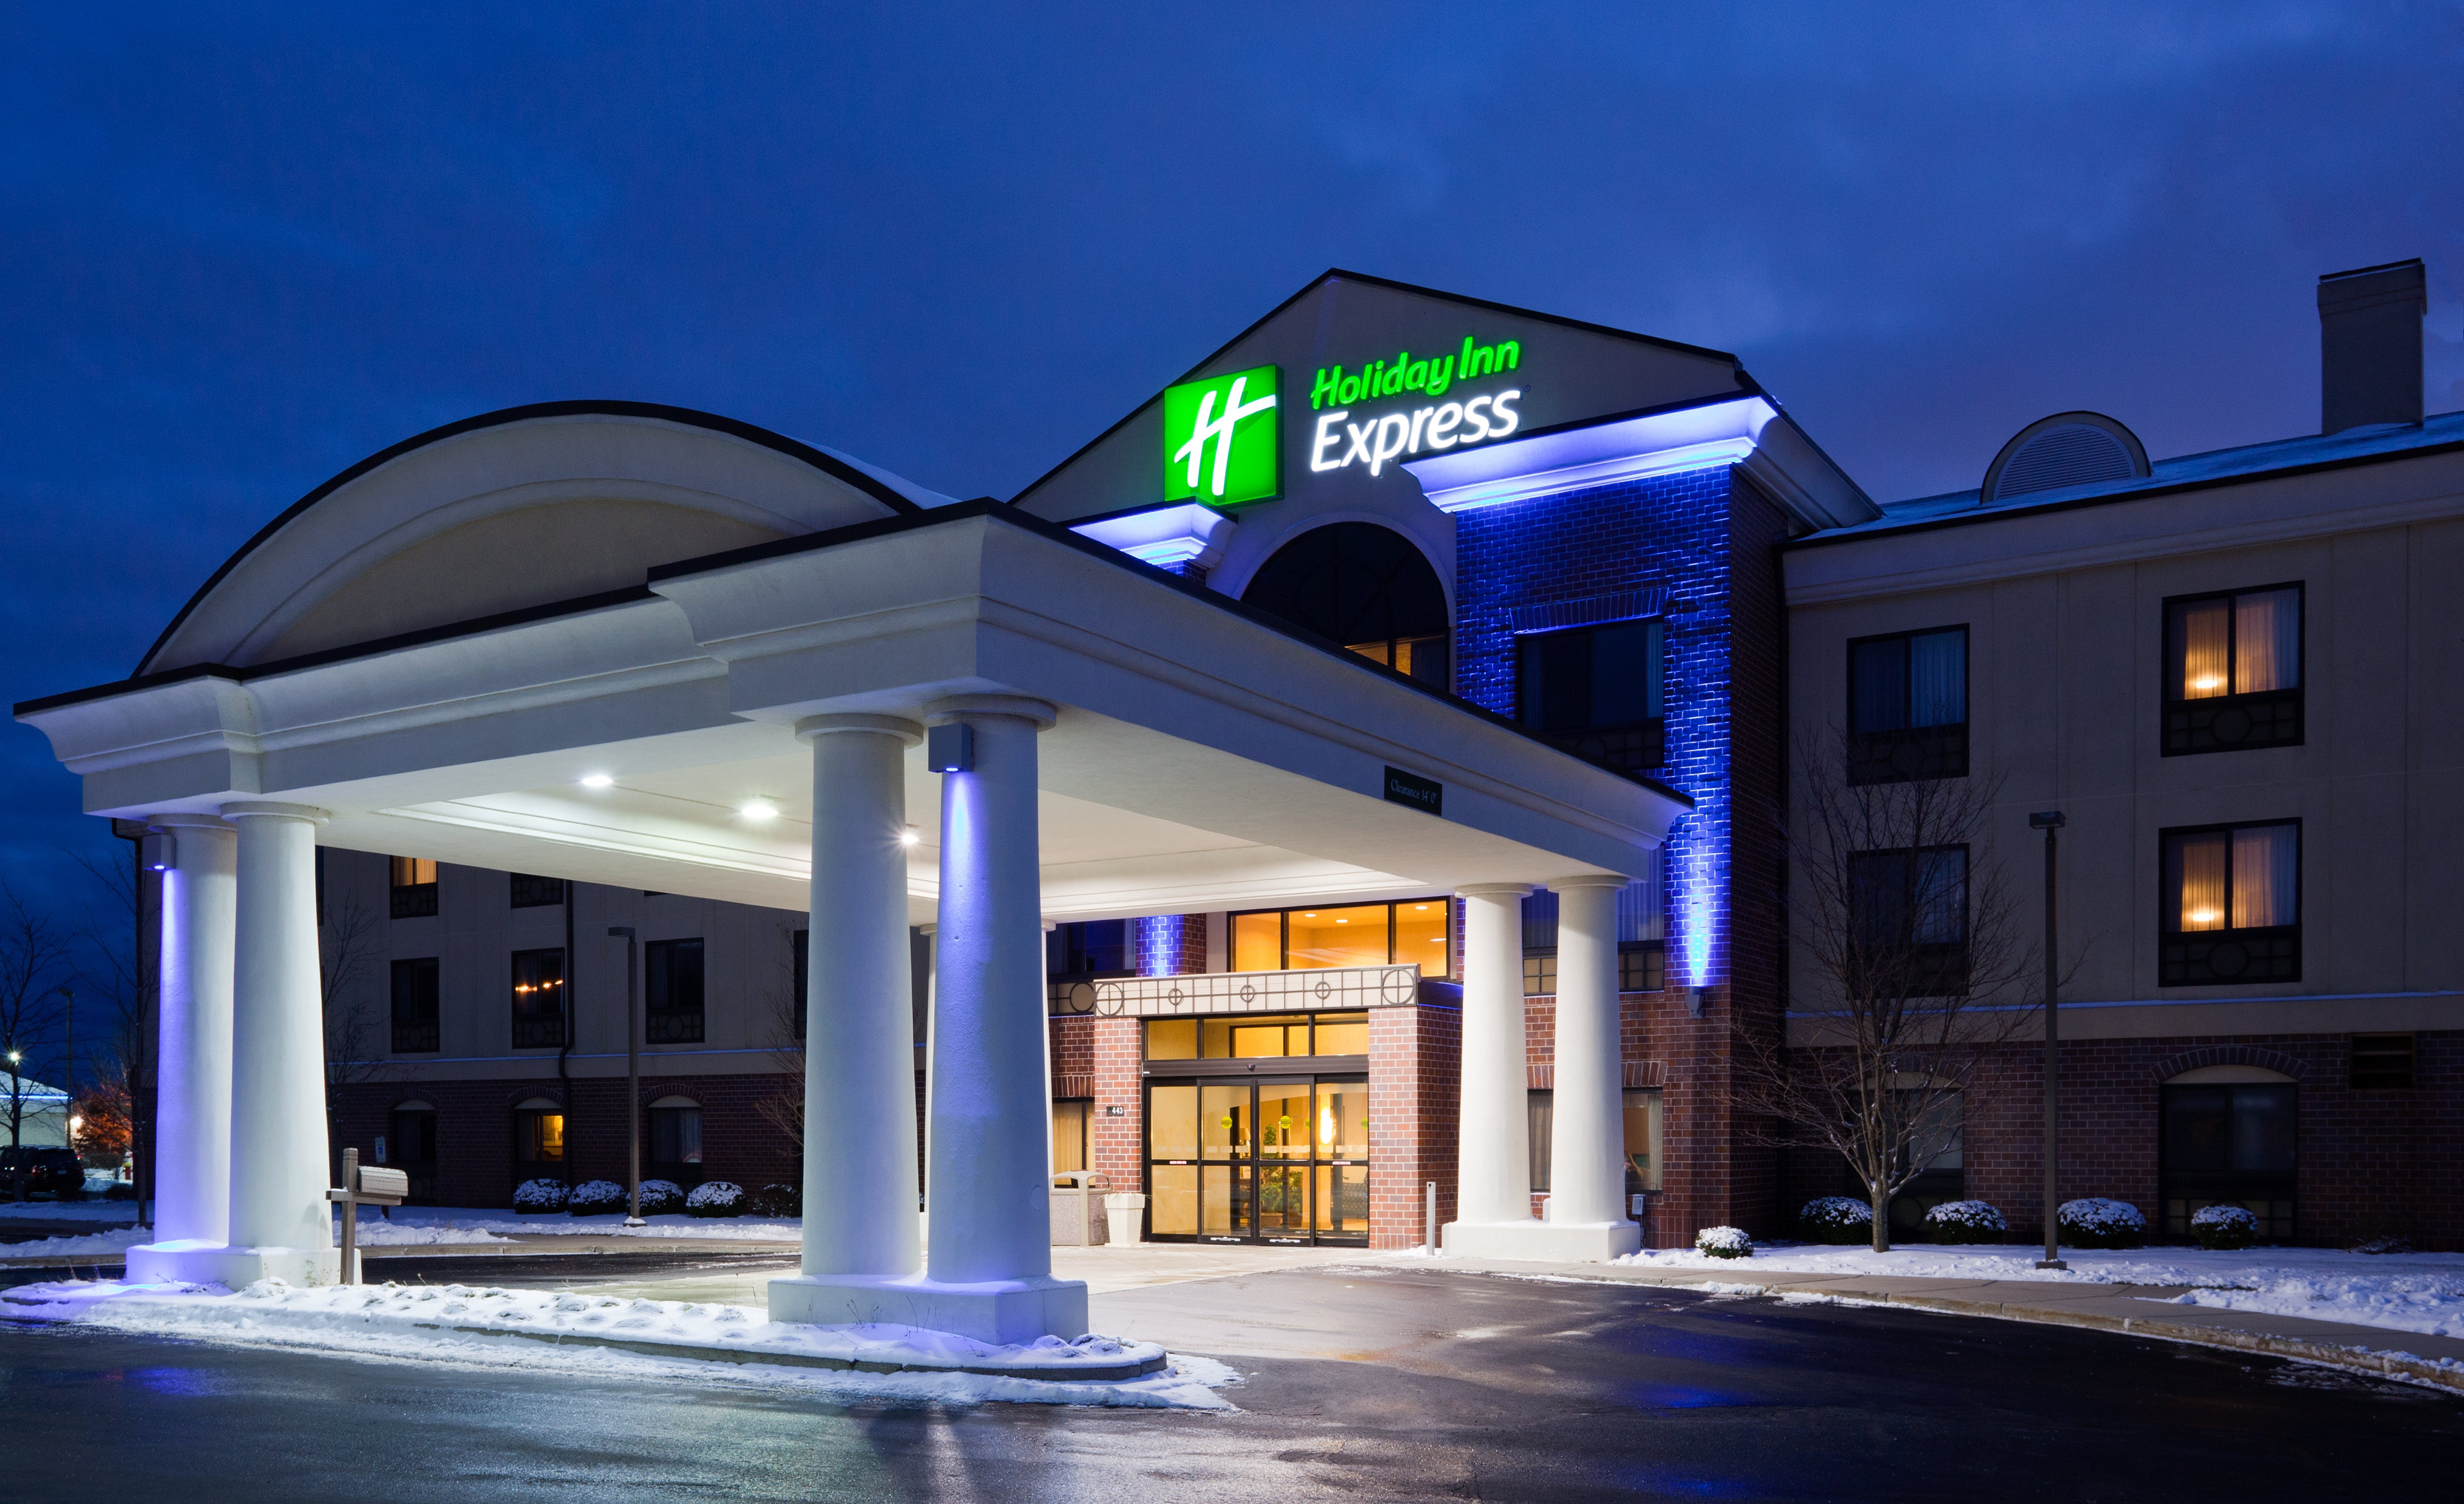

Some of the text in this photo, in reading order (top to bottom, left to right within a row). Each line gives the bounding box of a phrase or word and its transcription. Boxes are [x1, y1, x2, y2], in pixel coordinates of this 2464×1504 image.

[1311, 336, 1520, 410] Holiday Inn
[1174, 376, 1276, 496] H
[1311, 390, 1520, 476] Express
[1391, 779, 1420, 799] Clearance
